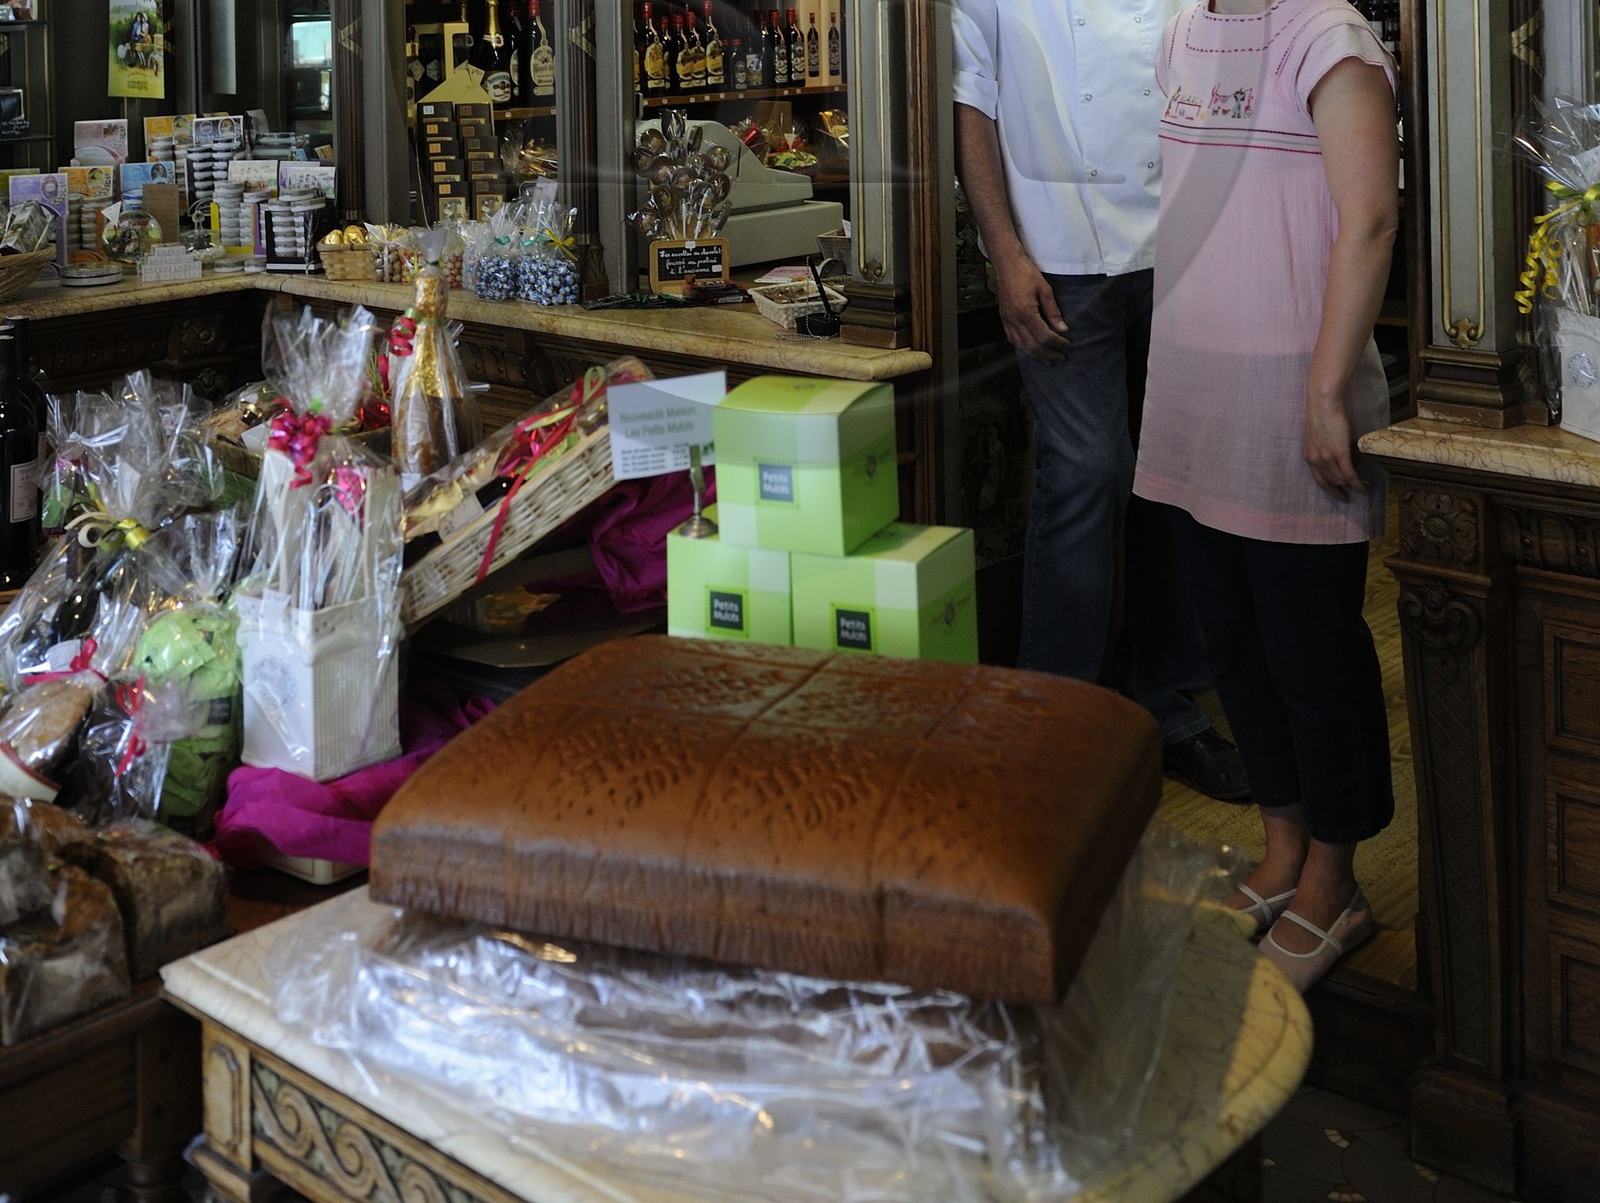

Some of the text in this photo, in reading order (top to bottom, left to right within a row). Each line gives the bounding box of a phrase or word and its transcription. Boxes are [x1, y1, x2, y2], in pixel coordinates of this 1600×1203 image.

[701, 246, 722, 256] chocolat
[620, 408, 664, 423] Nouveauté
[625, 422, 694, 438] Les Petits Mulots
[762, 471, 789, 484] Petits
[763, 483, 790, 495] Mulots
[713, 598, 739, 612] Petits
[713, 610, 740, 623] Mulots
[840, 617, 866, 631] Petits
[841, 630, 868, 642] Mulots
